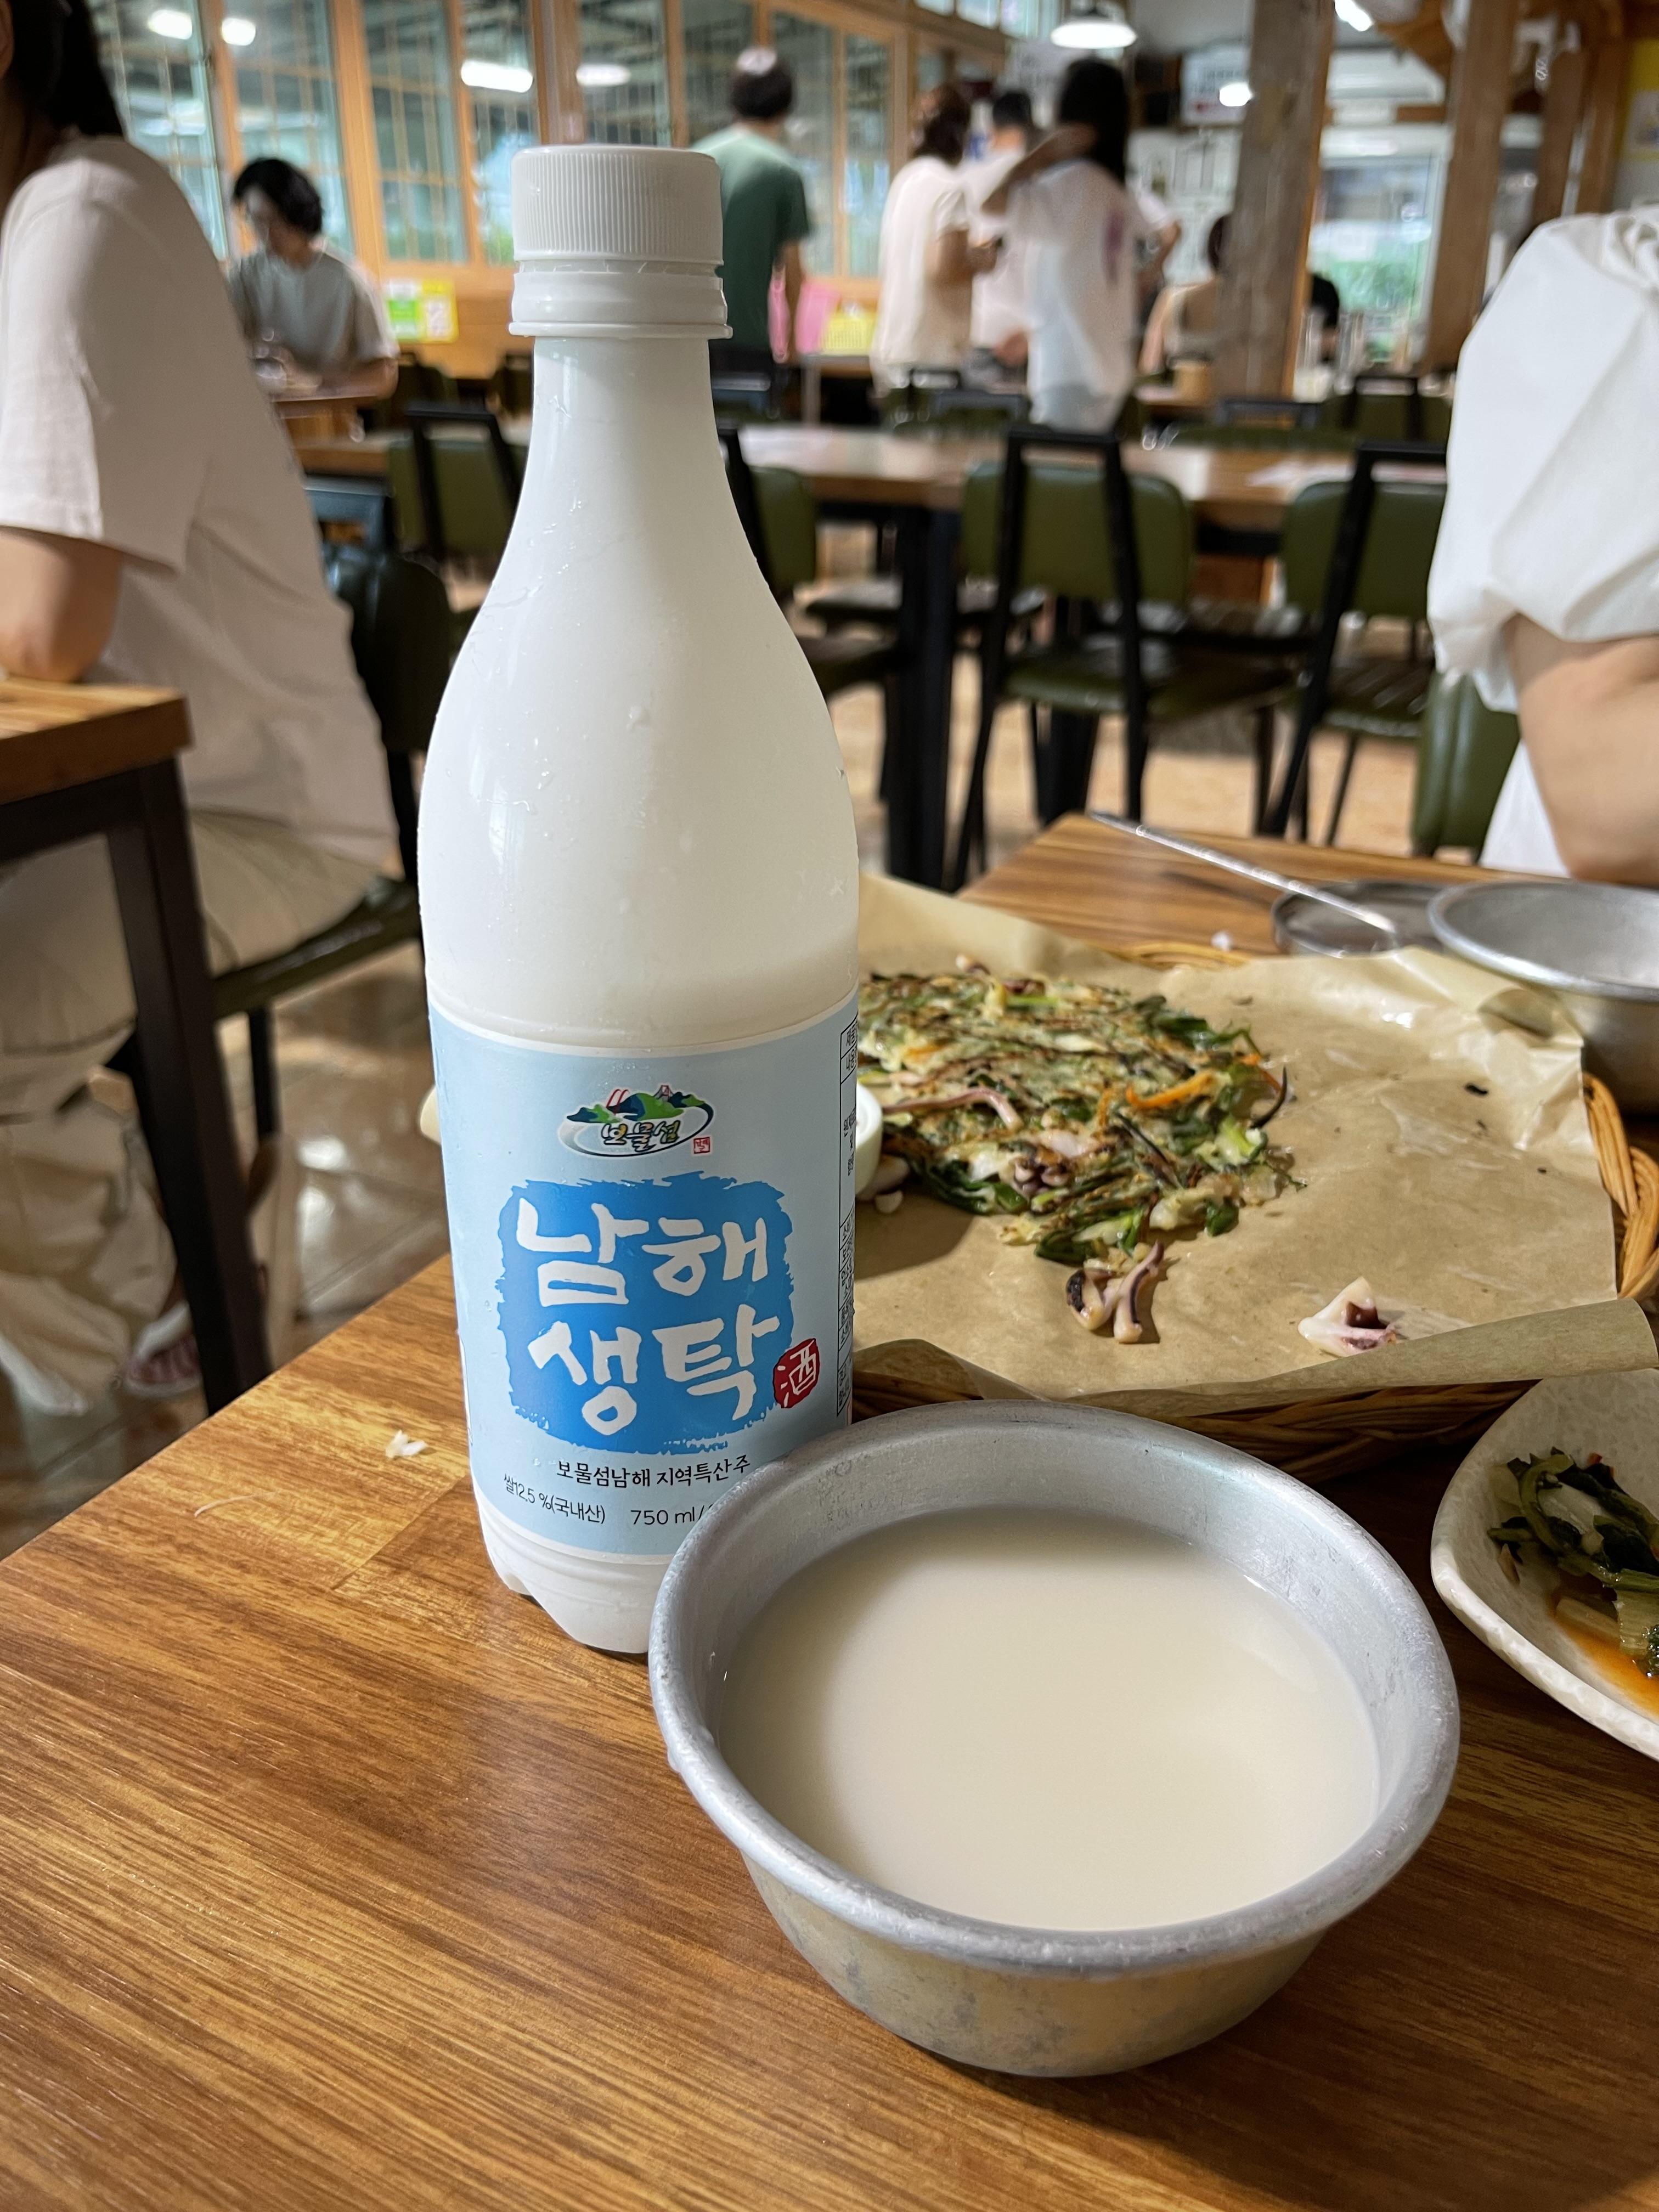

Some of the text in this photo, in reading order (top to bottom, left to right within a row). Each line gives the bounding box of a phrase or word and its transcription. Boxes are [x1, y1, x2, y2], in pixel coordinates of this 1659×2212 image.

[600, 1119, 681, 1153] 보물섬
[516, 1198, 768, 1307] 남해
[528, 1304, 780, 1436] 생탁
[777, 1340, 817, 1407] 酒
[556, 1454, 751, 1488] 보물섬남해 지역특산주
[630, 1509, 669, 1525] 750
